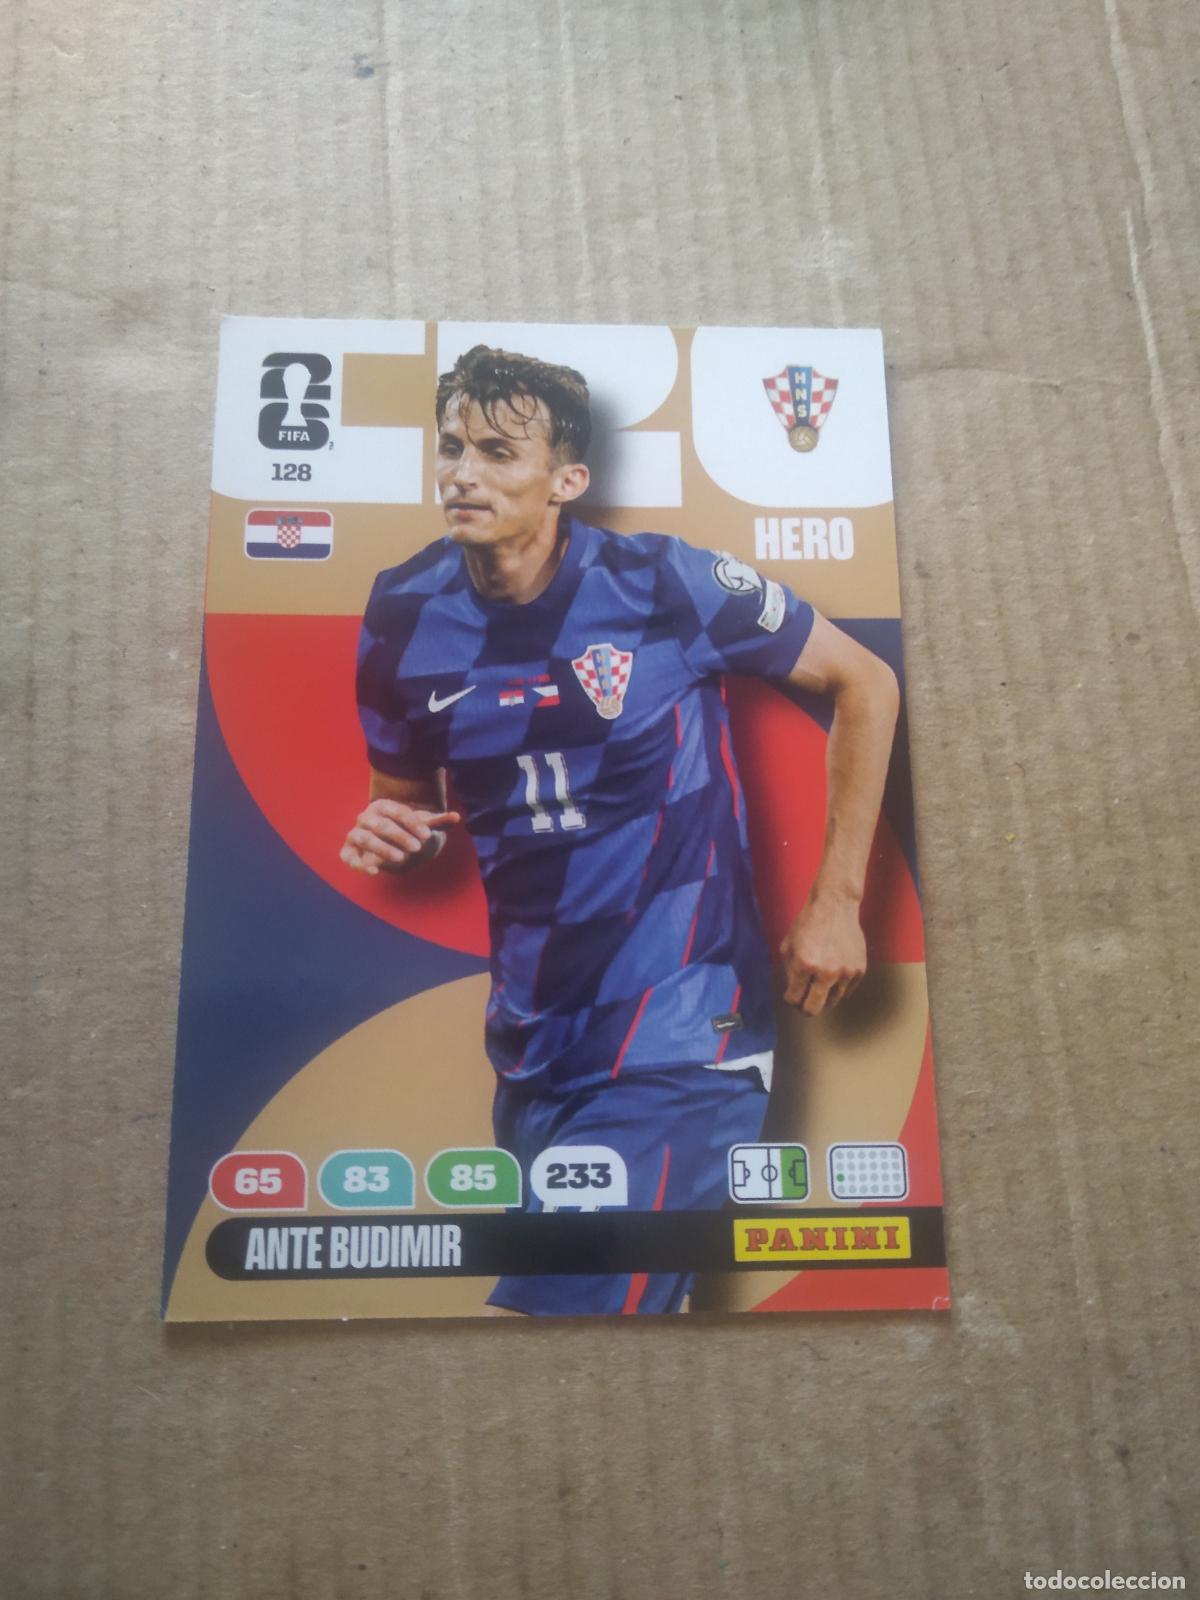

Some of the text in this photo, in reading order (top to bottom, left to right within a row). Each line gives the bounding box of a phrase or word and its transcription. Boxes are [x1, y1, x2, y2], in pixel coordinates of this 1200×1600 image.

[278, 430, 311, 442] FIFA
[271, 463, 312, 482] 128
[754, 517, 855, 561] HERO
[516, 752, 587, 833] 11
[234, 1167, 283, 1195] 65
[343, 1165, 390, 1193] 83
[450, 1164, 497, 1191] 85
[546, 1163, 612, 1189] 233
[244, 1224, 462, 1271] ANTE BUDIMIR
[744, 1226, 900, 1252] PANINI
